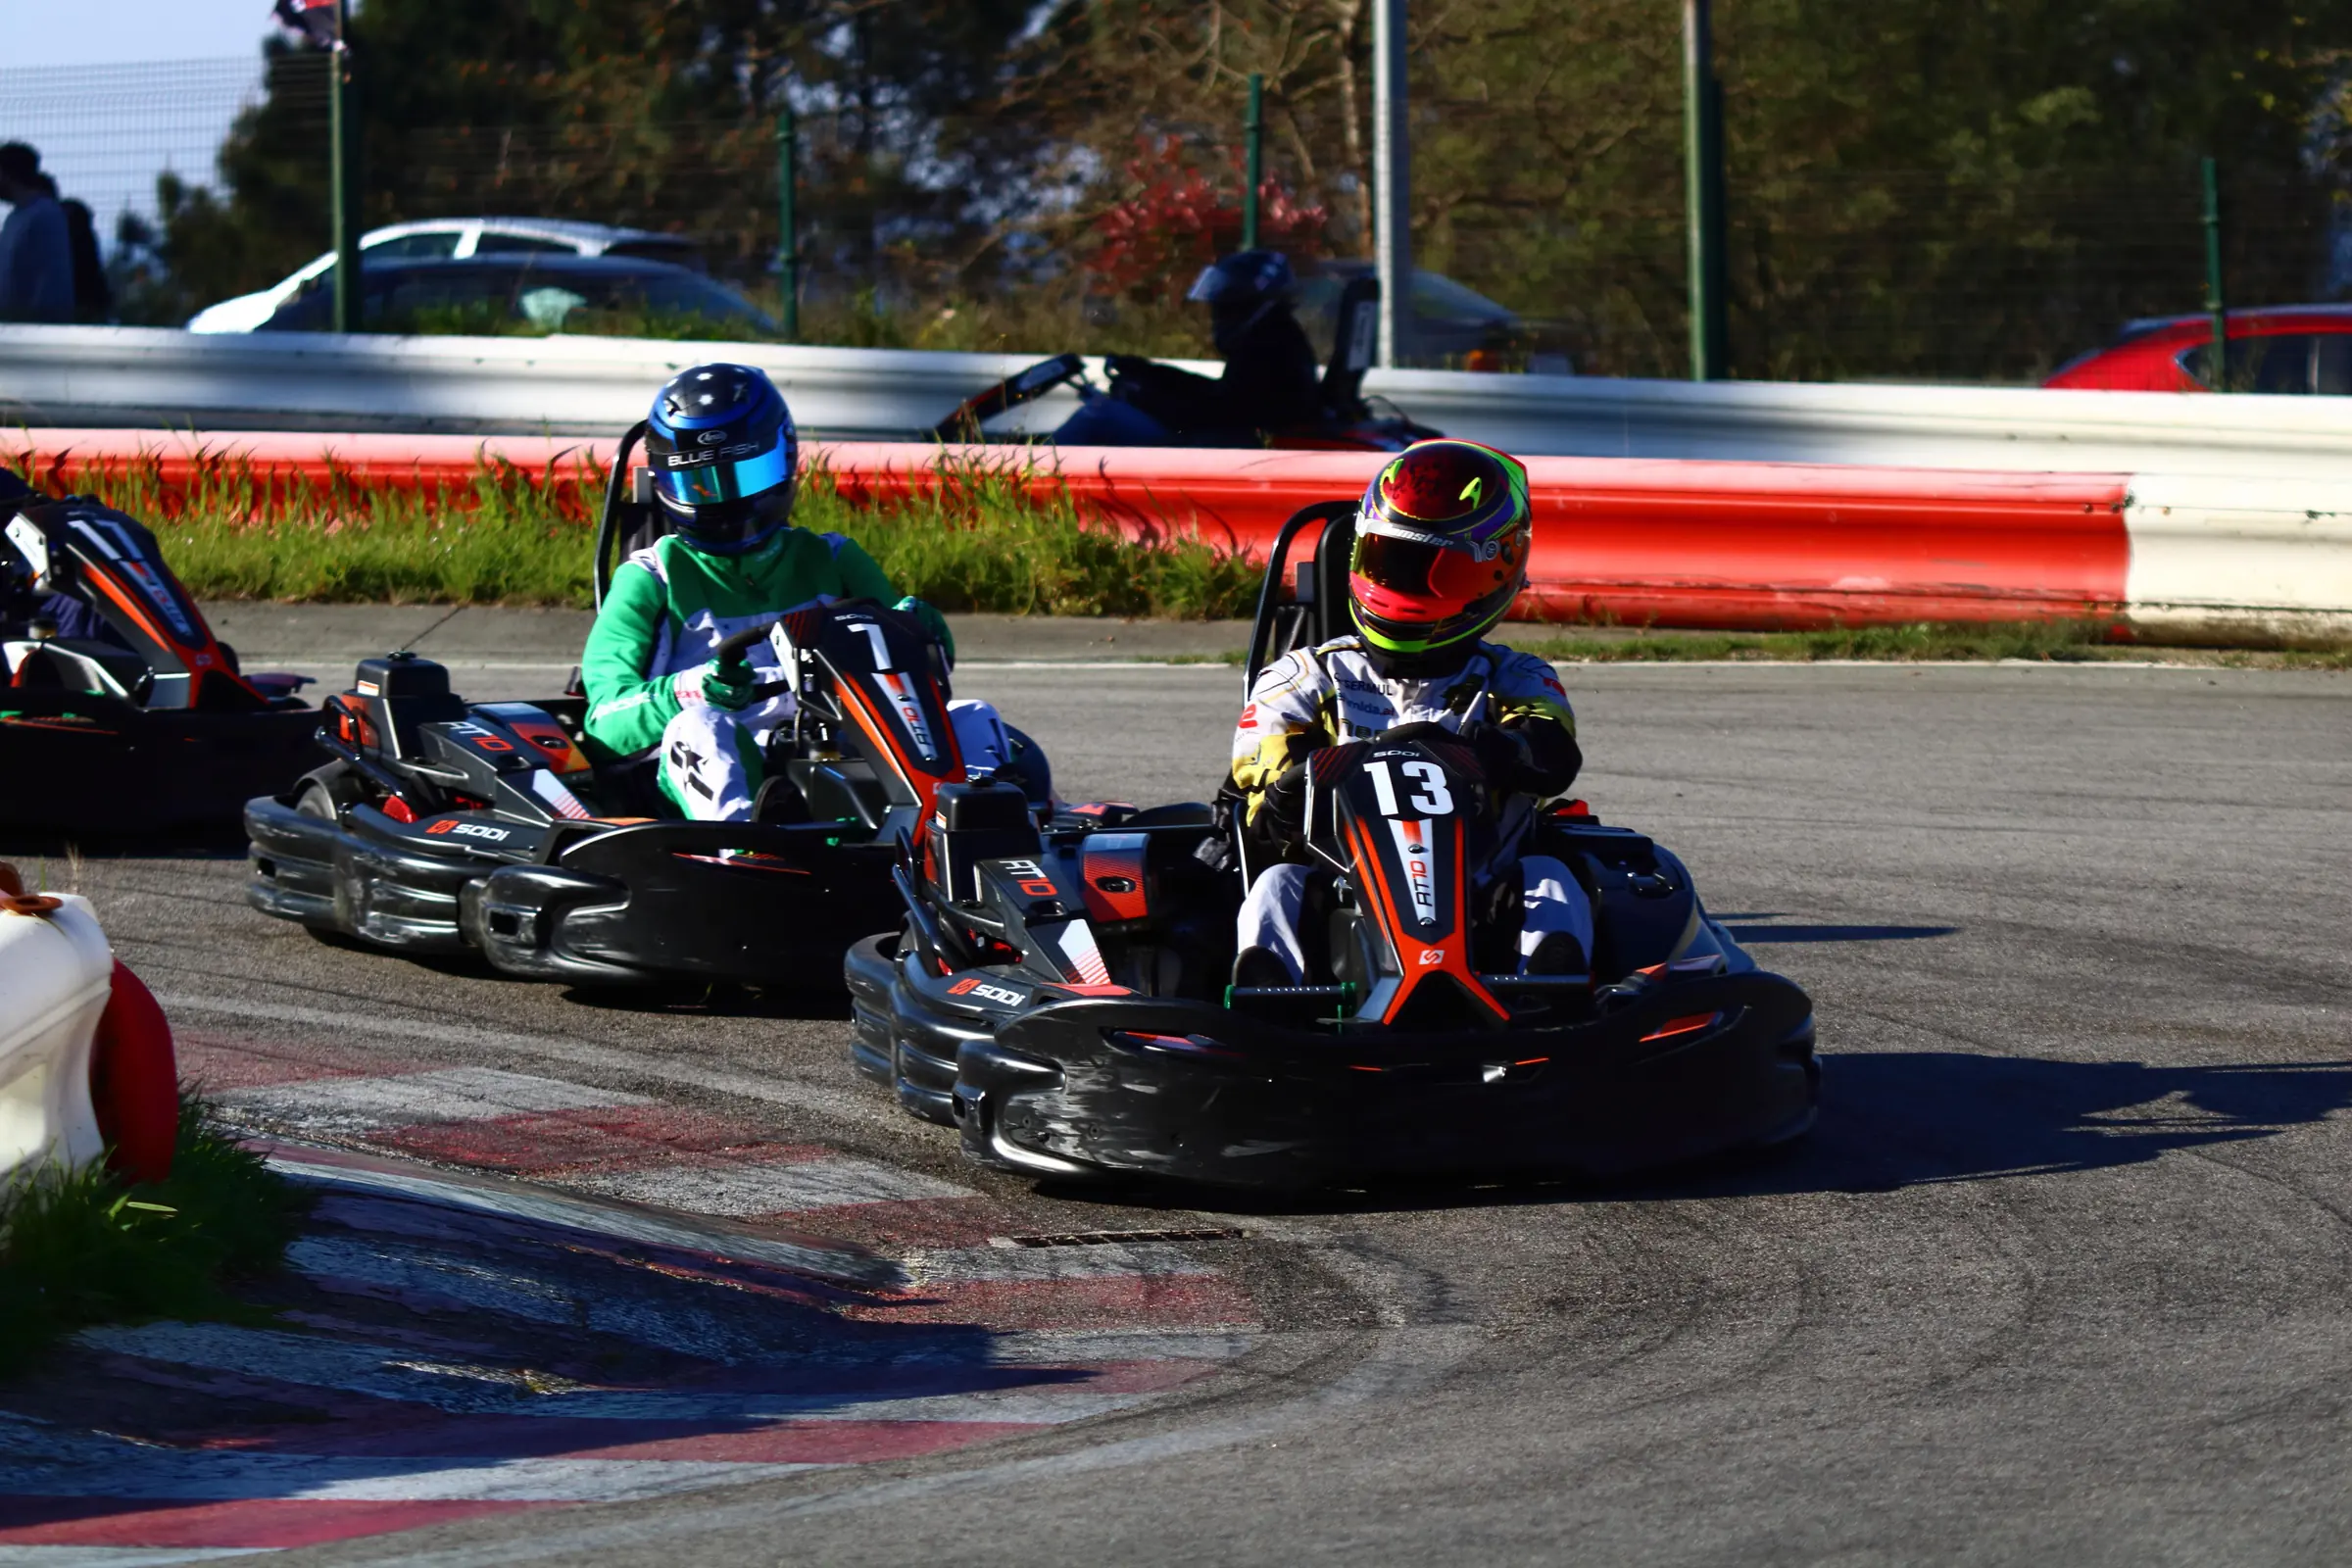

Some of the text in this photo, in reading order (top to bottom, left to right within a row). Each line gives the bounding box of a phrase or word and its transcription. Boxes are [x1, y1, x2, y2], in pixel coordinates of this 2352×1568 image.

[667, 450, 714, 466] BLUE
[1362, 760, 1454, 816] 13
[1000, 859, 1058, 897] RT10
[1409, 860, 1433, 907] RT10
